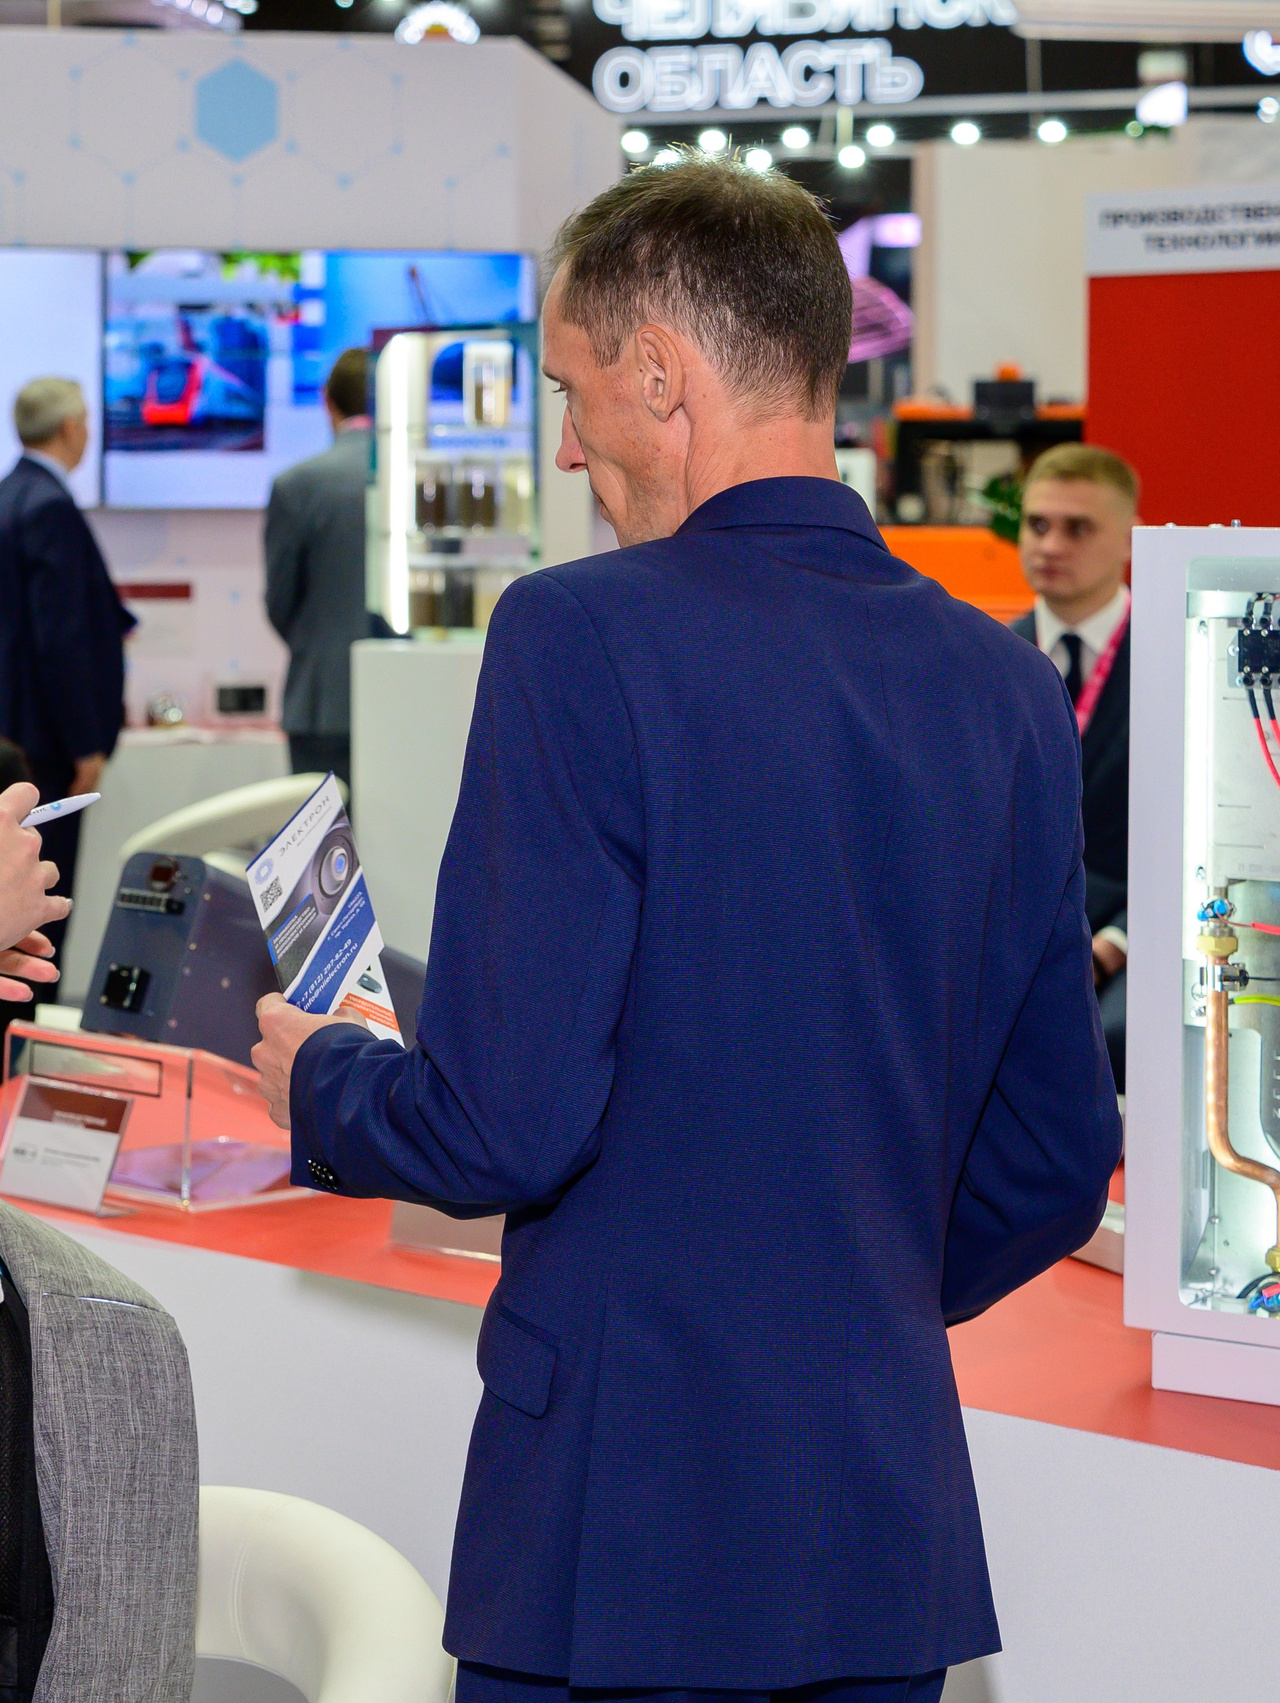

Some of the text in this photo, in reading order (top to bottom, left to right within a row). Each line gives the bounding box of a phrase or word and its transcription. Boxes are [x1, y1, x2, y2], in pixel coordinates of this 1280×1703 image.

[592, 37, 925, 112] ОБЛАСТЬ
[278, 795, 330, 857] ЭЛЕКТРОН
[301, 938, 352, 1002] +7 (812) 297-82-49
[303, 942, 358, 1012] info@niielectron.ru
